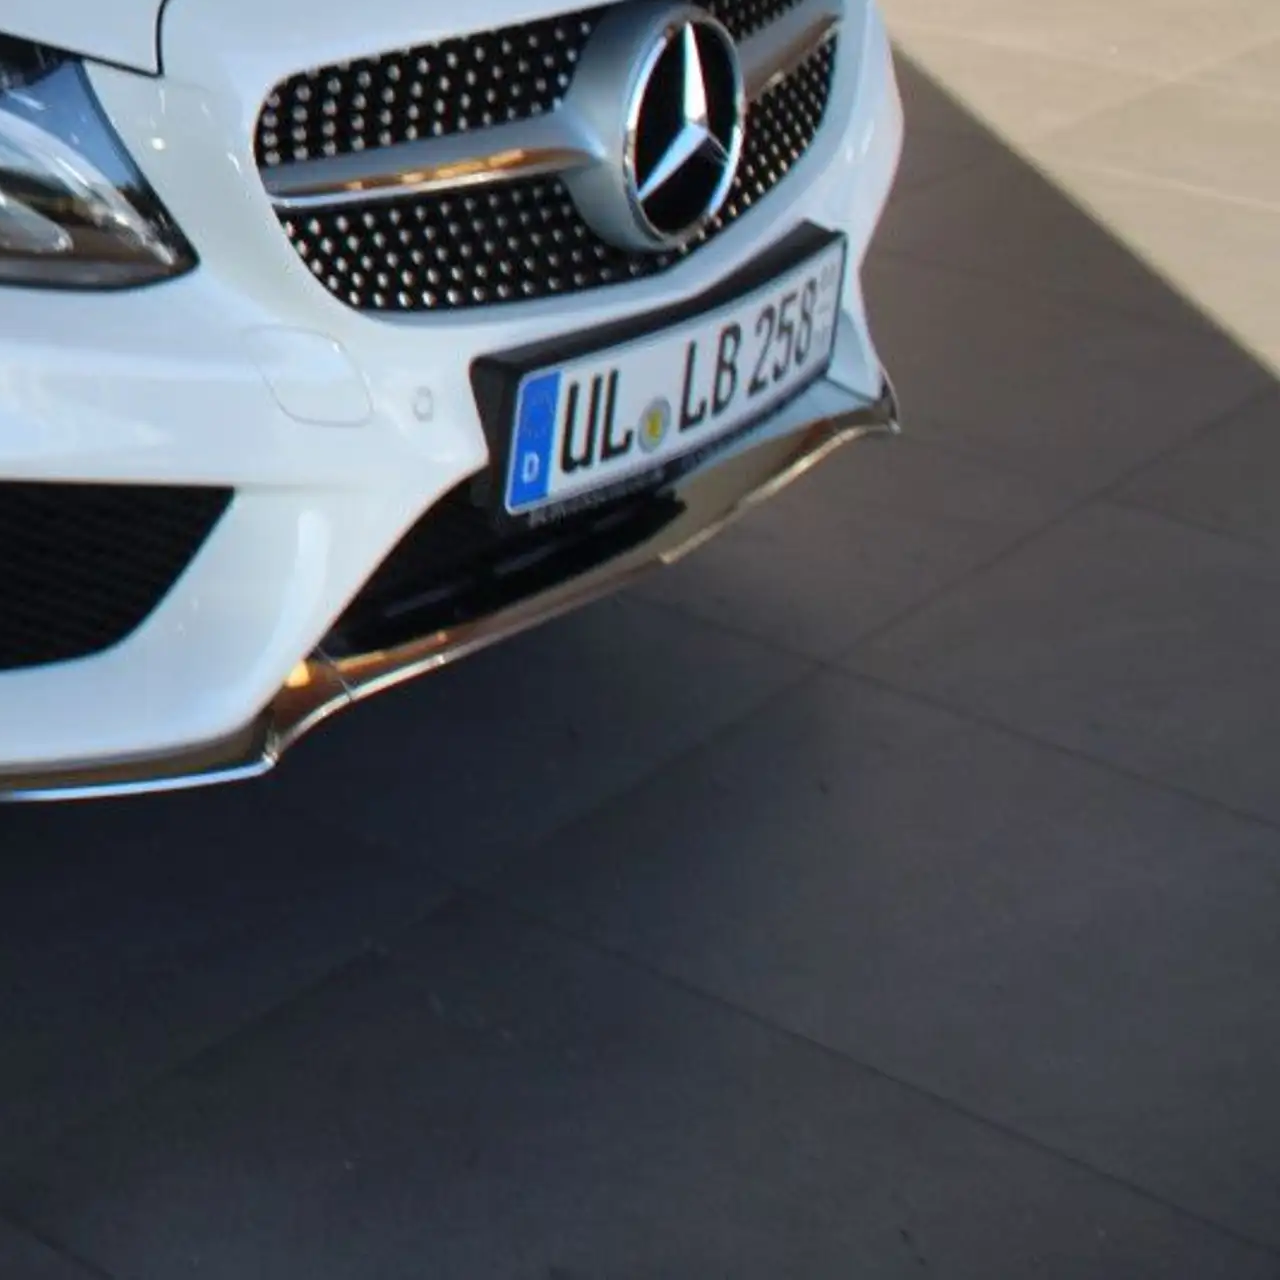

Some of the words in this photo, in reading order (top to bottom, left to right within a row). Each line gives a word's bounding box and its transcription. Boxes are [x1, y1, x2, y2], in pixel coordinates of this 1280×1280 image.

[561, 369, 633, 474] UL
[678, 322, 742, 434] LB
[747, 277, 817, 397] 258
[521, 451, 540, 485] D
